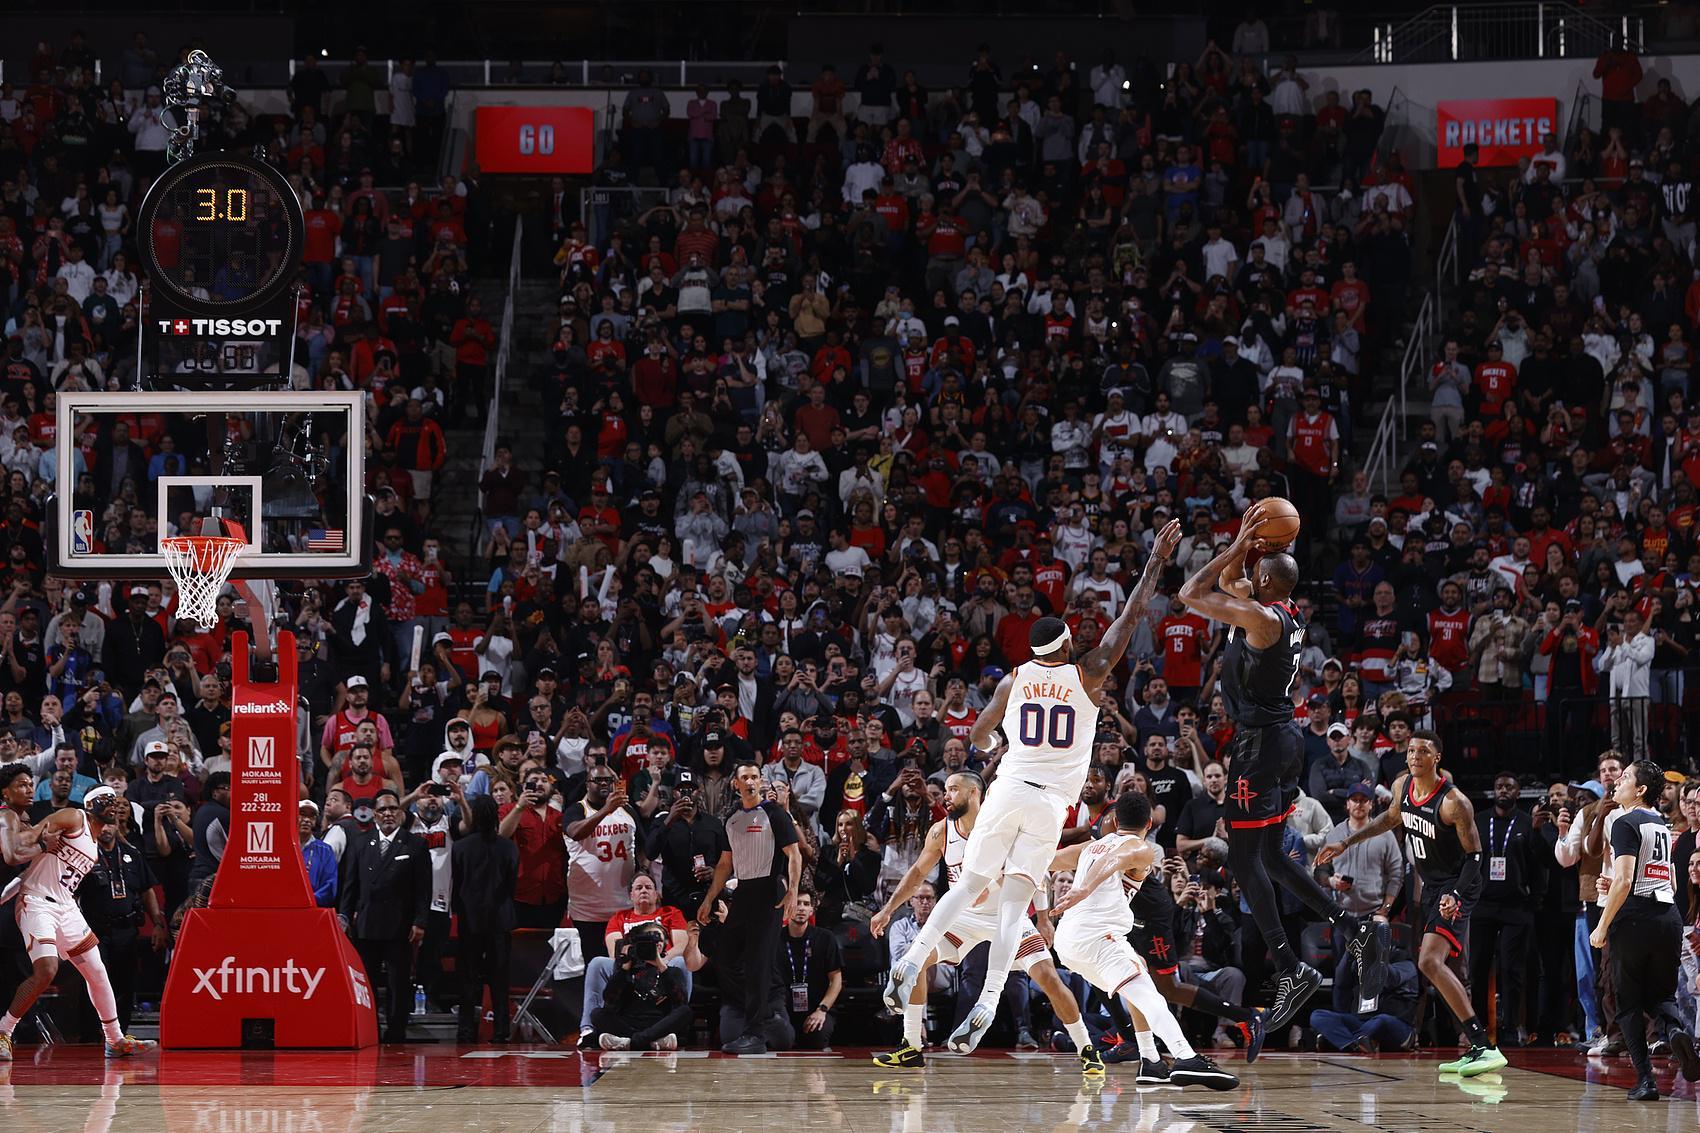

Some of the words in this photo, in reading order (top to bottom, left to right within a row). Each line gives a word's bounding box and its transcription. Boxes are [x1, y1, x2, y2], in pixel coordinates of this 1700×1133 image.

[518, 124, 556, 156] GO
[1446, 117, 1550, 147] ROCKETS
[196, 188, 247, 221] 3.0
[192, 319, 282, 335] TISSOT
[1046, 582, 1053, 594] 7
[1164, 624, 1194, 637] ROCKETS
[1435, 621, 1463, 631] ROCKETS
[1442, 629, 1452, 641] 31
[1173, 638, 1183, 653] 15
[1023, 684, 1073, 704] O'NEALE
[234, 702, 277, 714] reliant
[1019, 702, 1076, 748] 00
[241, 803, 282, 812] 222-2222
[253, 793, 268, 802] 281
[597, 840, 627, 863] 34
[1411, 834, 1427, 860] 10
[1653, 831, 1669, 863] 91
[60, 866, 82, 893] 23
[192, 956, 327, 1001] xfinity
